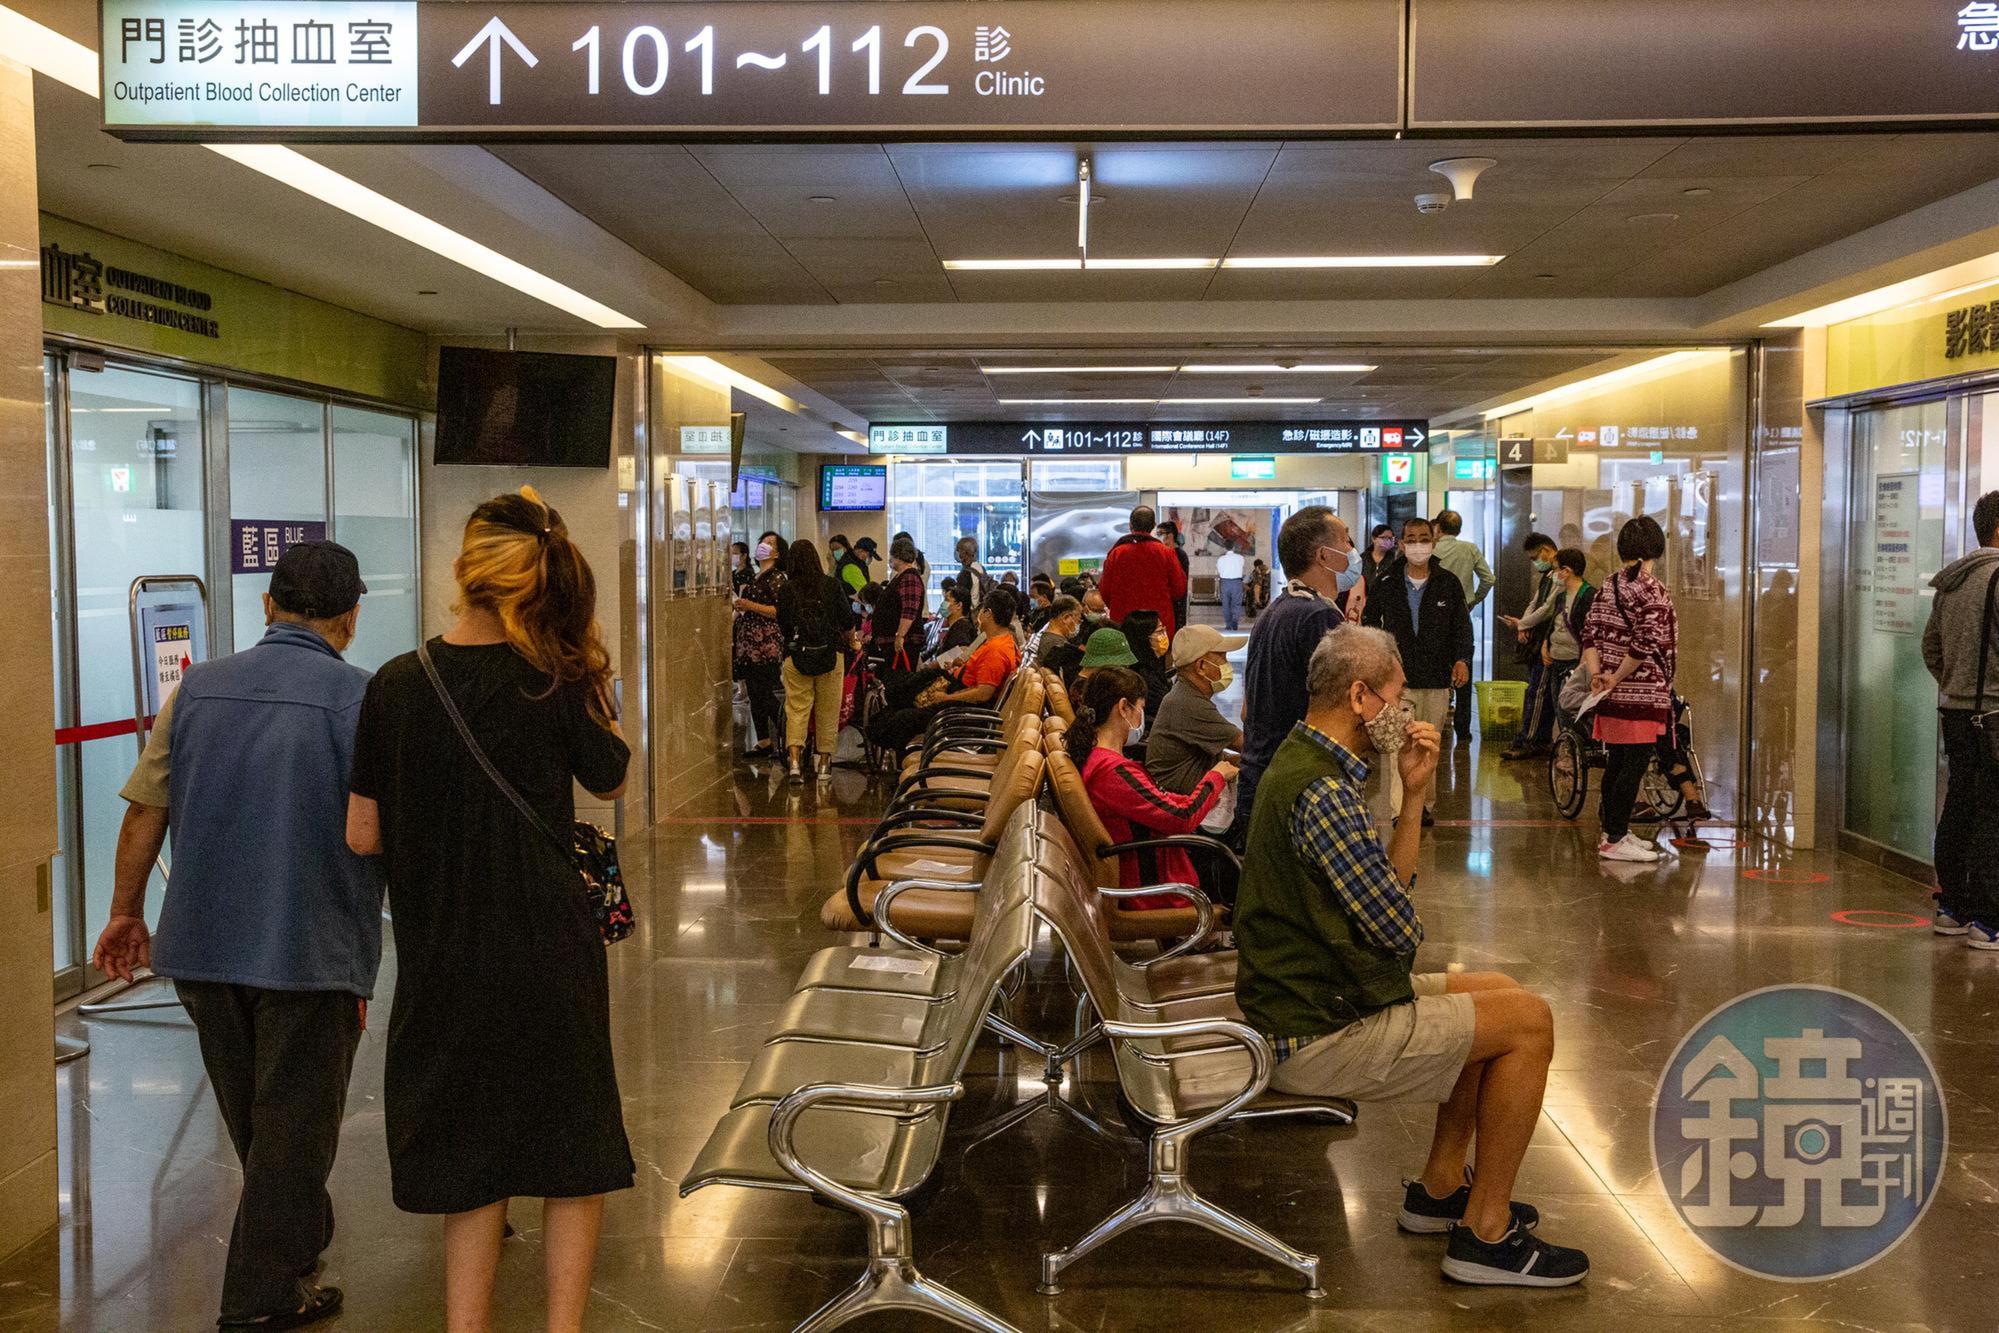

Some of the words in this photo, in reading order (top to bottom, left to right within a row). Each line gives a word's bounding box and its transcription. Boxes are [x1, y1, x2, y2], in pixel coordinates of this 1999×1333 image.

[1956, 1, 1999, 51] 急
[121, 18, 393, 65] 門診抽血室
[572, 24, 950, 97] 101~112
[974, 25, 1012, 63] 診
[113, 81, 200, 105] Outpatient
[205, 81, 253, 102] Blood
[258, 82, 340, 102] Collection
[345, 82, 402, 102] Center
[974, 70, 1046, 97] Clinic
[106, 293, 178, 329] COLLECTION
[178, 311, 220, 339] CENTER
[873, 429, 943, 443] 門診抽血室
[1064, 430, 1132, 449] 101~112
[1508, 442, 1522, 462] 4
[284, 526, 304, 544] BLUE
